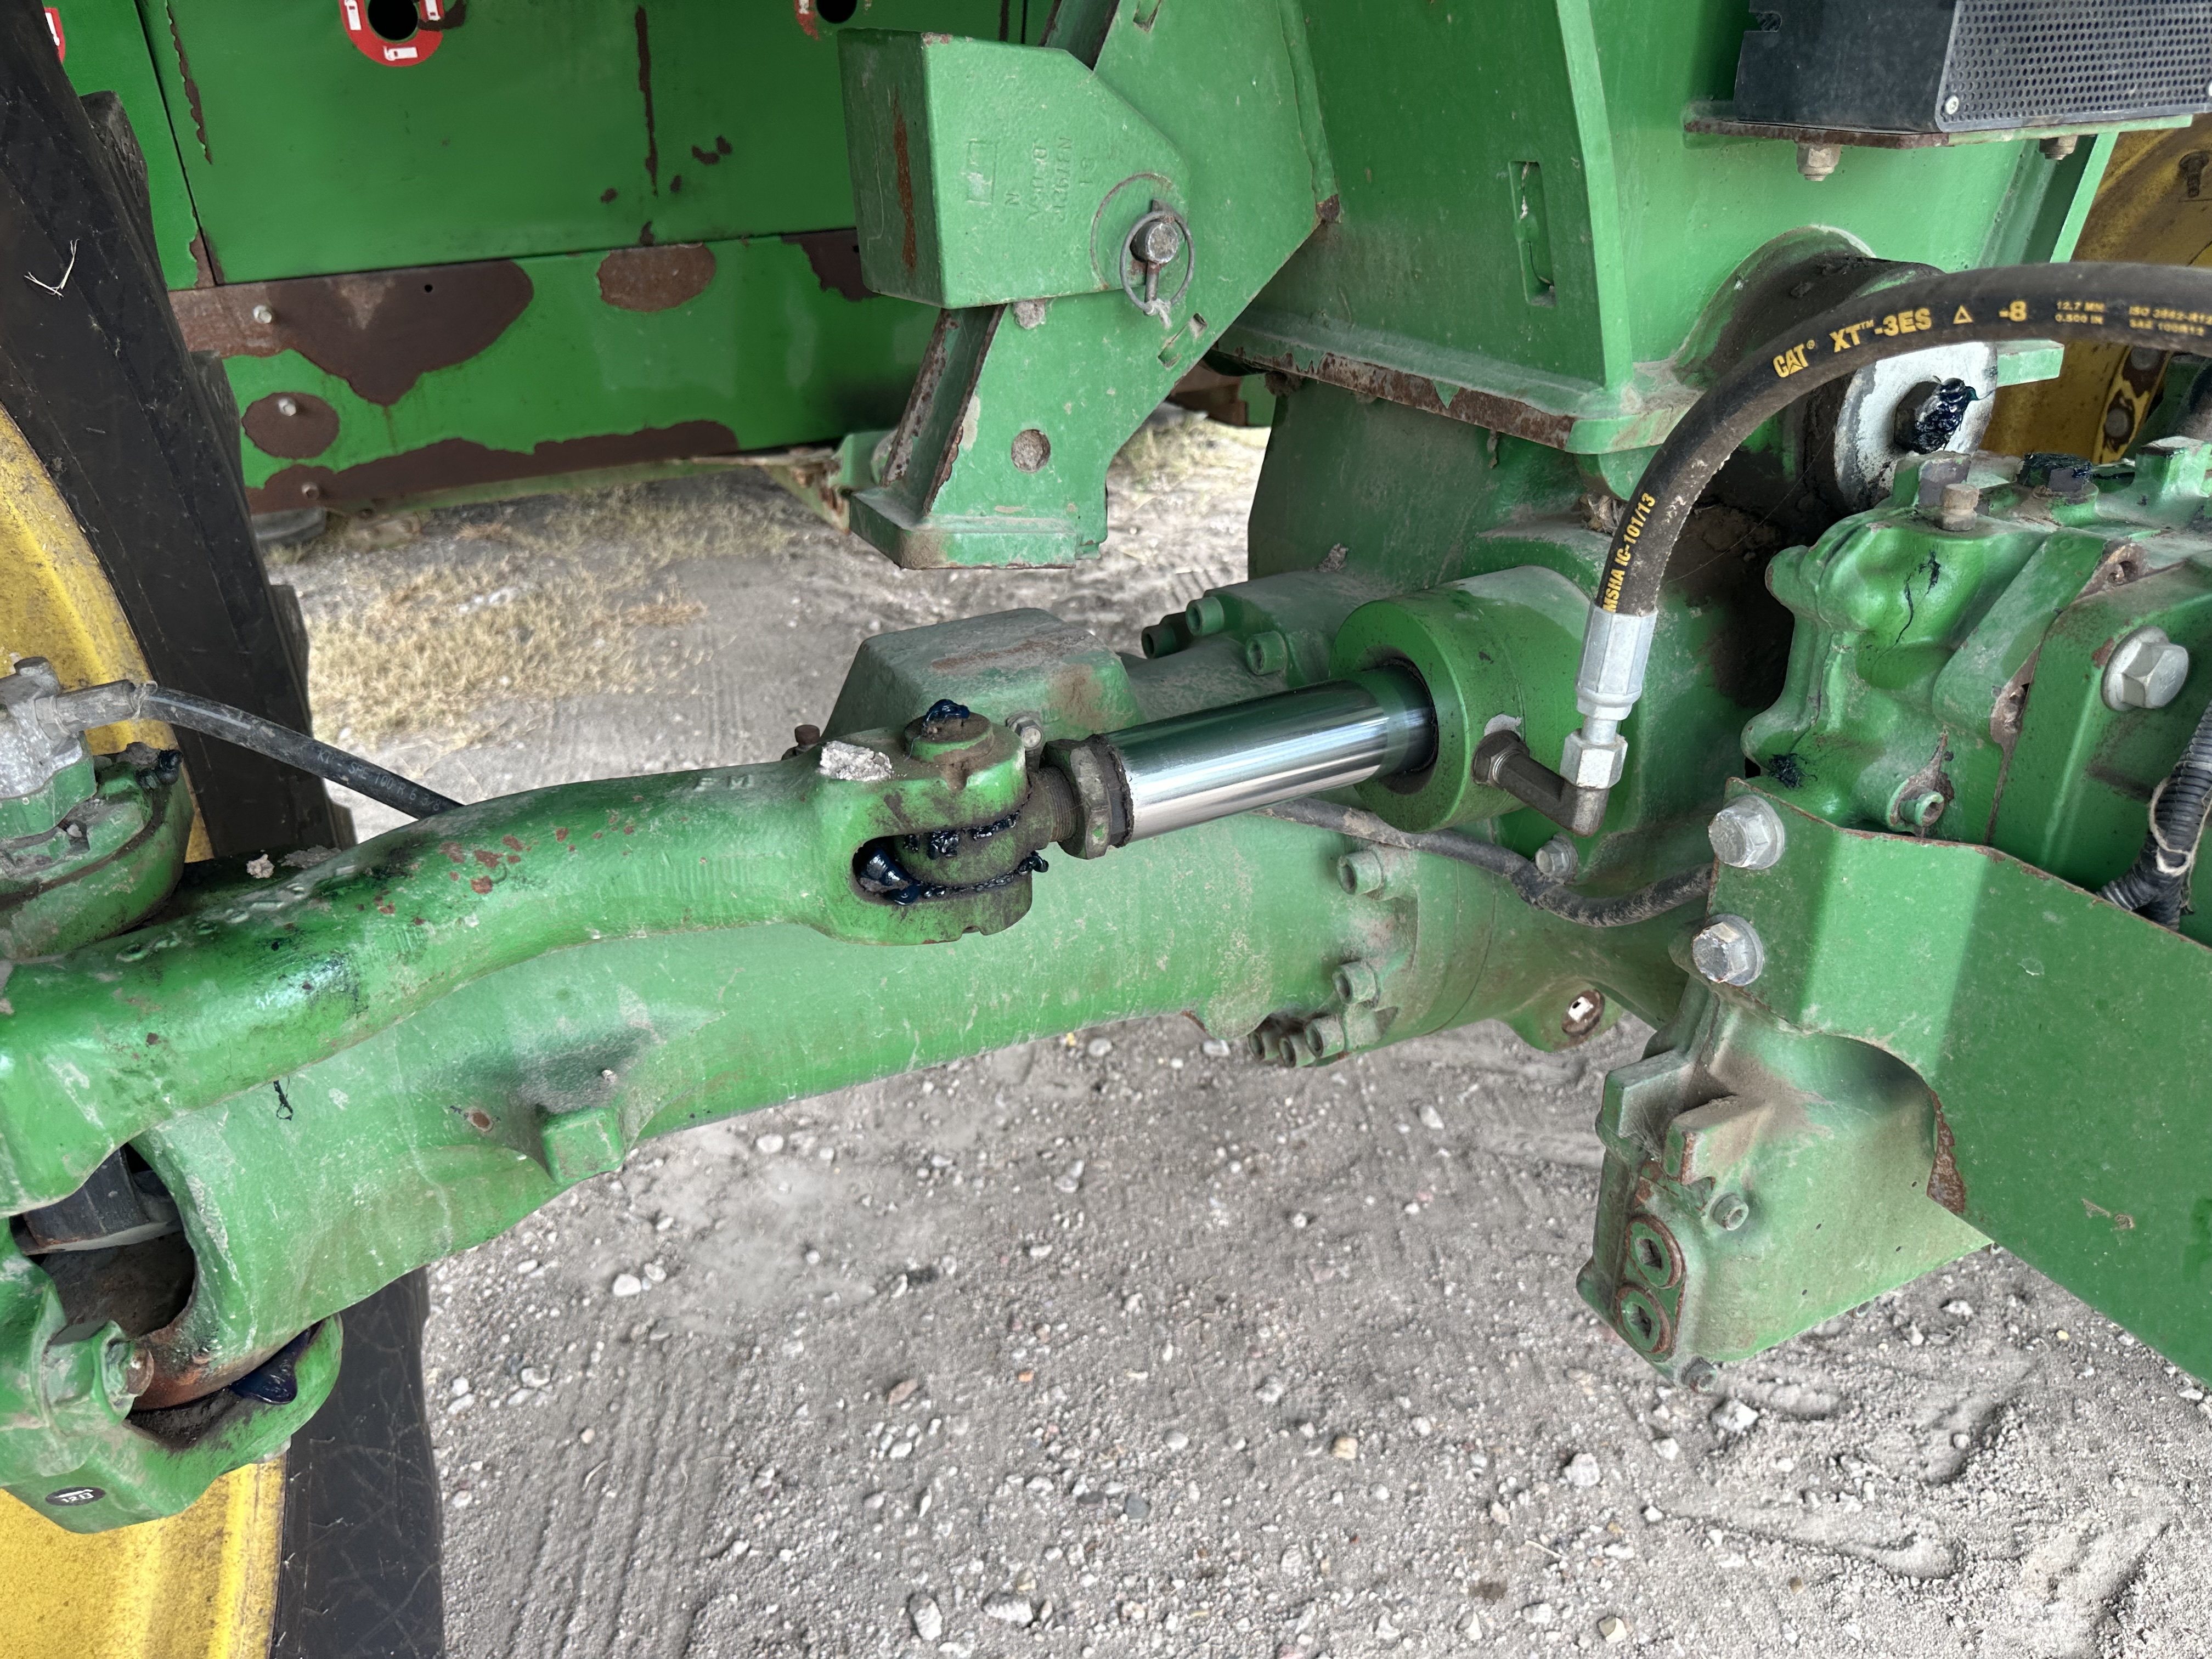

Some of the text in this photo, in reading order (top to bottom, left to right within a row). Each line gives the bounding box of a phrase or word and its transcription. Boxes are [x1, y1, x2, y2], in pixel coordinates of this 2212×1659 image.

[1999, 300, 2027, 322] -8
[2056, 301, 2081, 311] 12.7
[1602, 493, 1656, 613] MSHA IC-101/13
[348, 762, 369, 780] SAE
[375, 772, 394, 790] 100
[397, 782, 407, 795] R
[409, 788, 417, 800] 6
